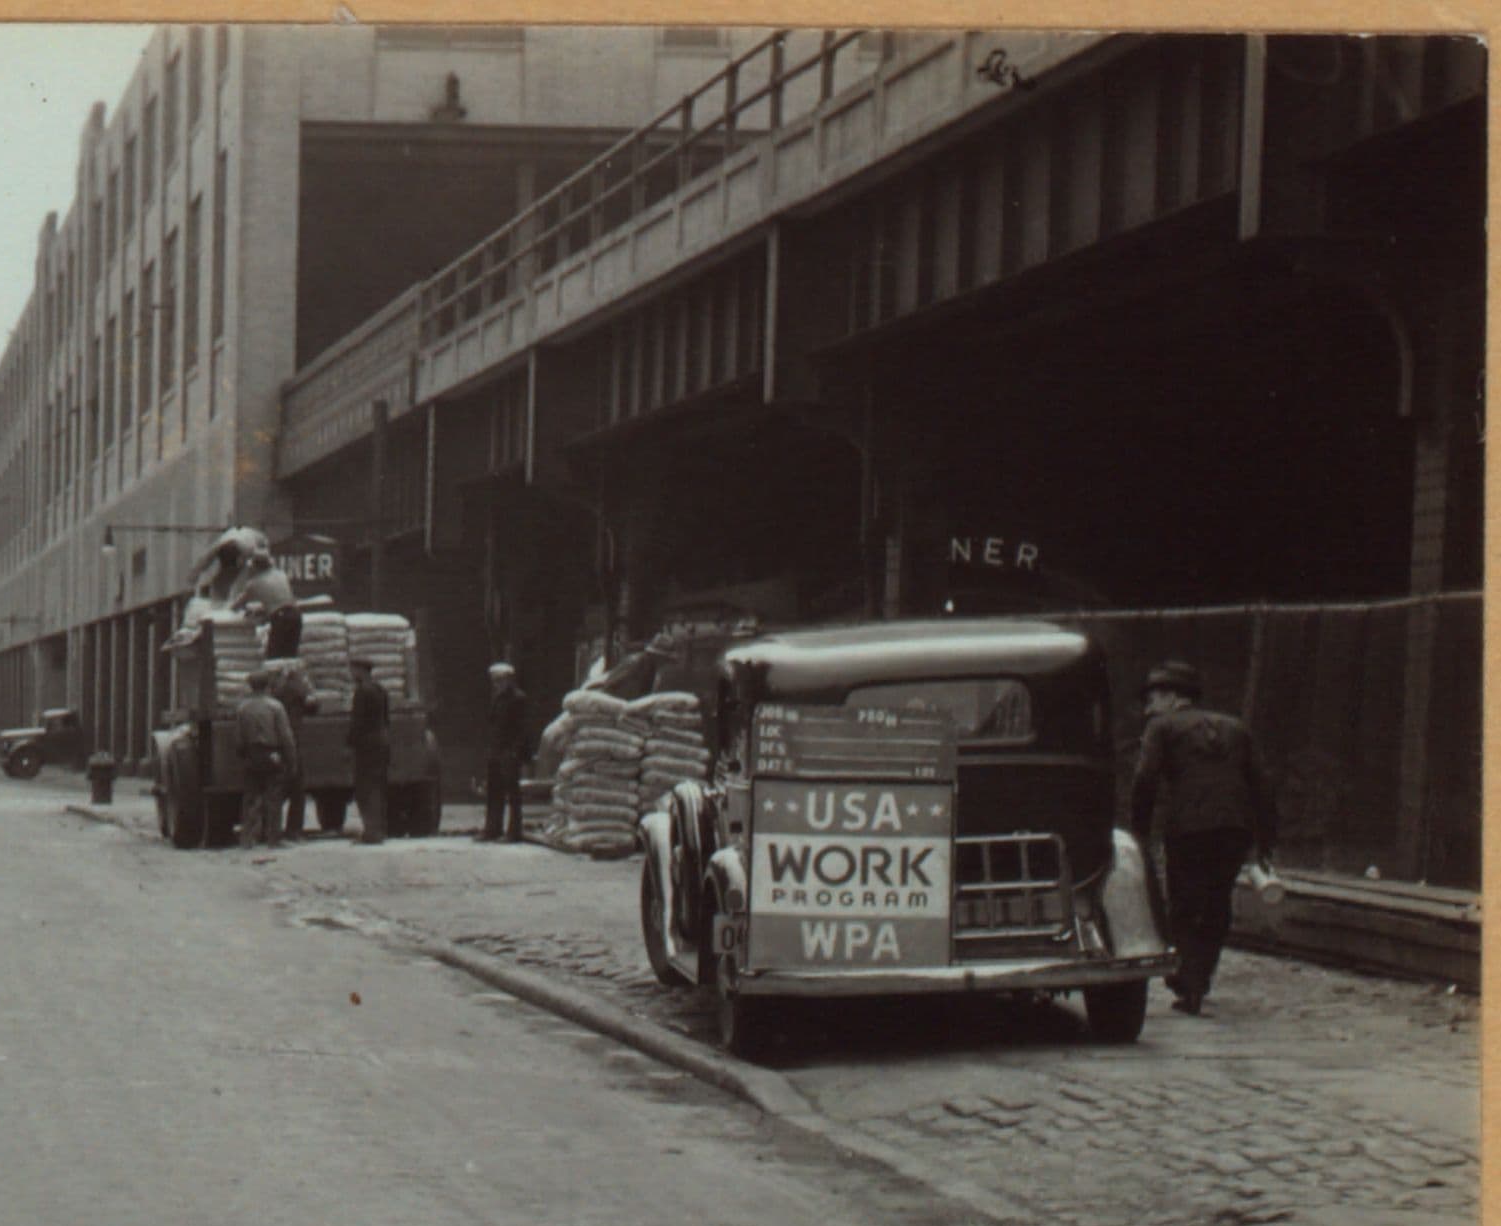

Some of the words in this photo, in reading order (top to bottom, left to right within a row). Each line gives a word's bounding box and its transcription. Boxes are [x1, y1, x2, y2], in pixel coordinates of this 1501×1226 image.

[805, 791, 903, 831] USA
[768, 843, 935, 887] WORK
[771, 889, 929, 908] PROGRAM
[800, 920, 901, 961] WPA
